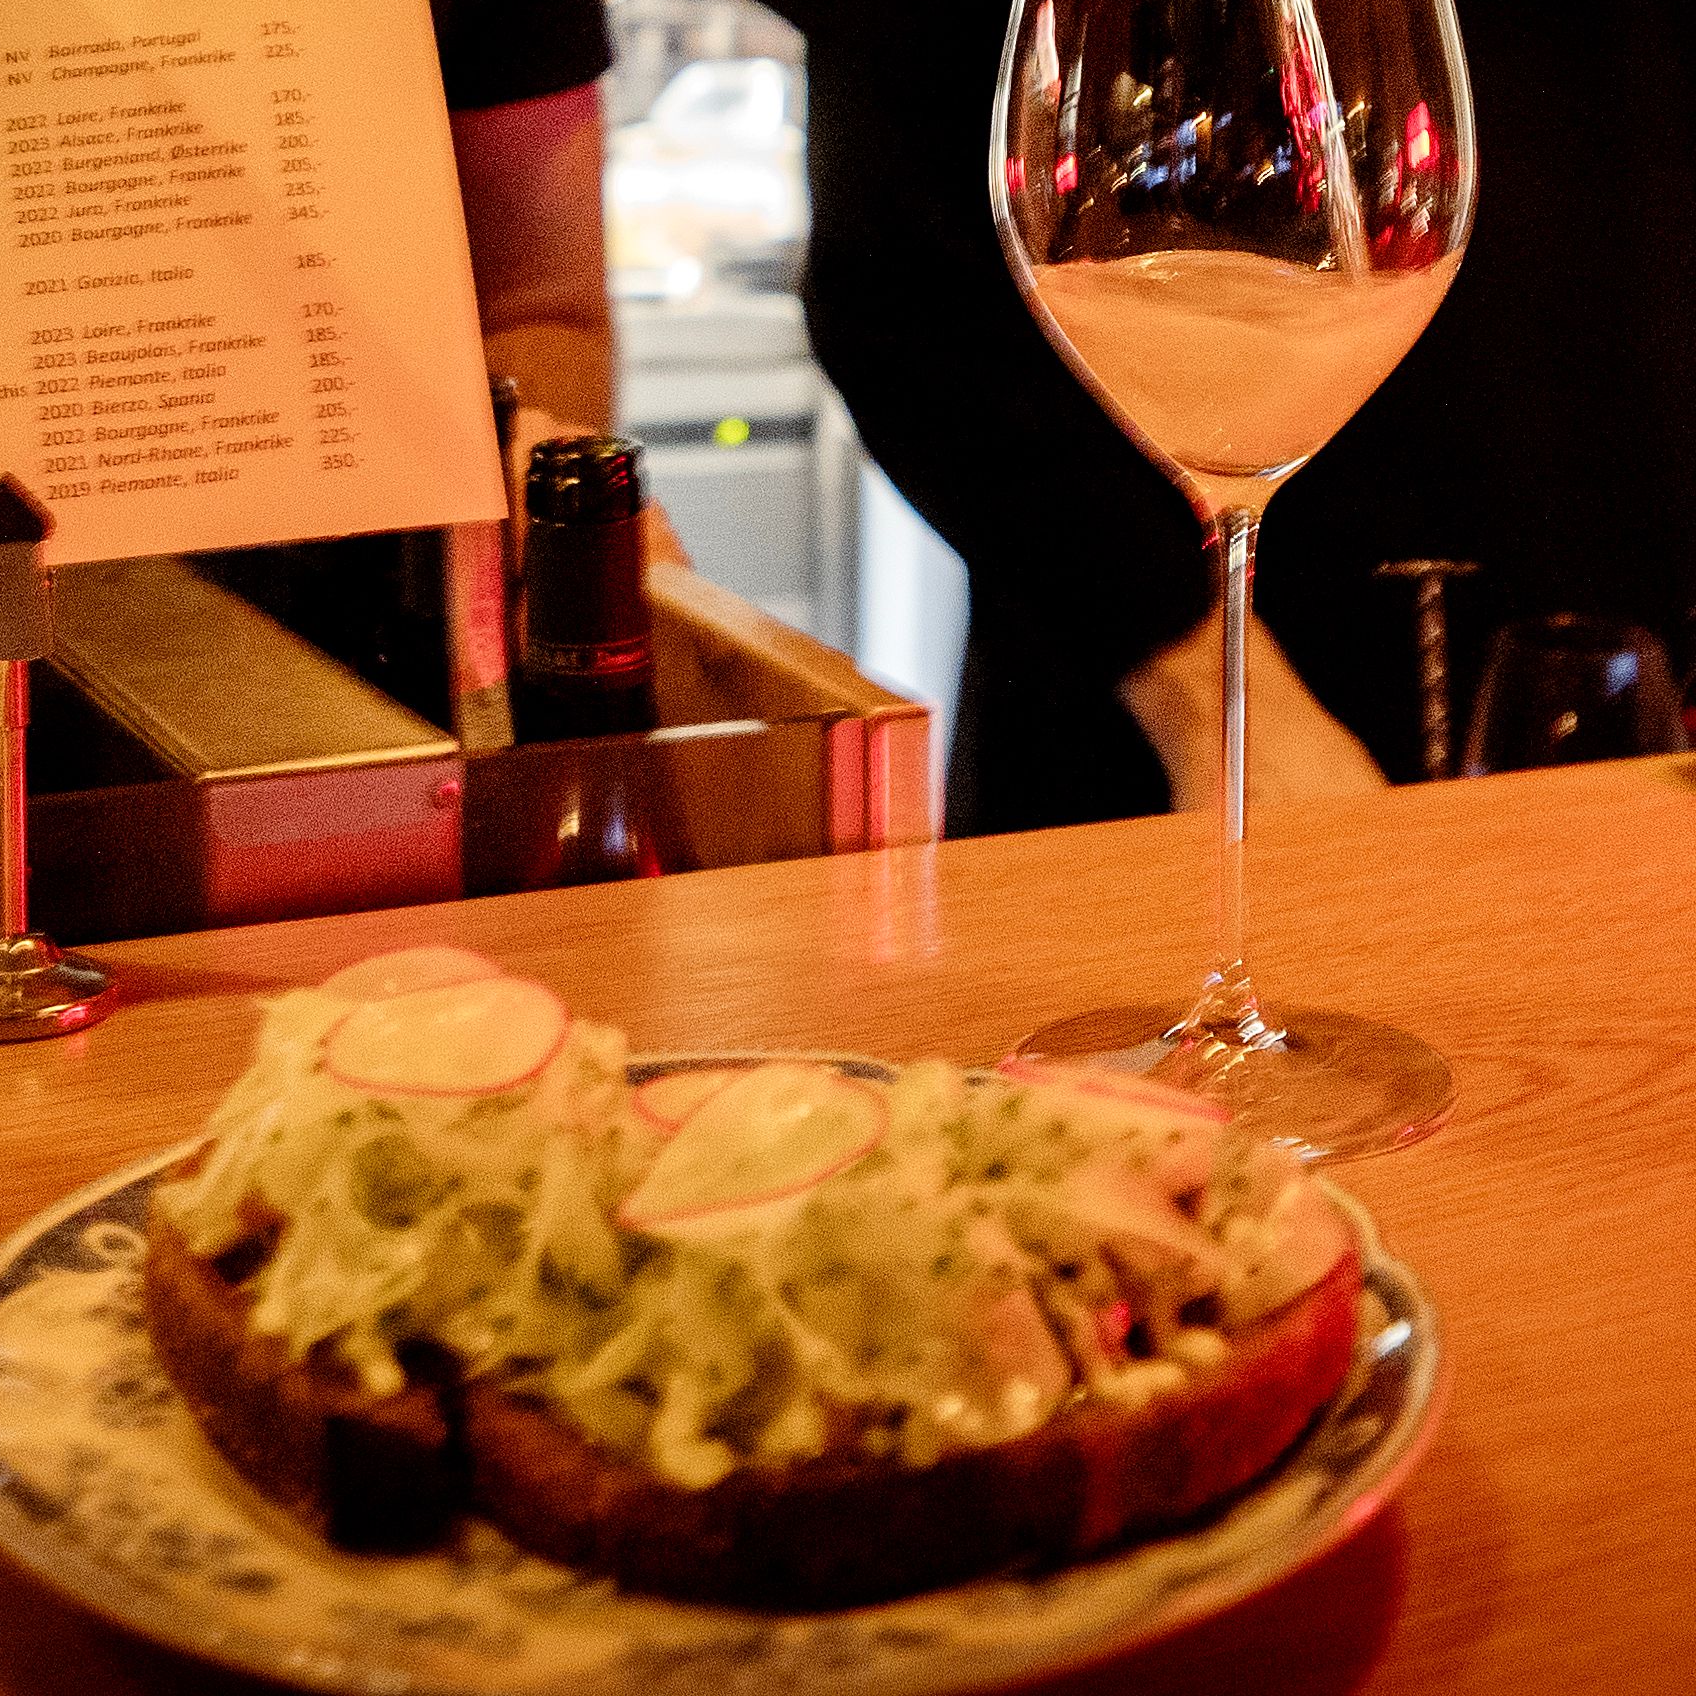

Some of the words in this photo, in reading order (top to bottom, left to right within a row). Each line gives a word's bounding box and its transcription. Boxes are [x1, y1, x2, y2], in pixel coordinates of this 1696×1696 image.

[1, 49, 30, 65] NV
[131, 30, 200, 49] Portugal
[260, 19, 302, 37] 175,-
[4, 70, 32, 87] NV
[50, 59, 154, 82] Champagne,
[160, 49, 235, 68] Frankrike
[264, 42, 306, 60] 225,-
[4, 113, 47, 134] 2022
[55, 110, 104, 127] Loire,
[108, 99, 185, 119] Frankrike
[271, 87, 312, 105] 170,-
[7, 136, 49, 156] 2023
[57, 131, 119, 148] Alsace,
[126, 120, 203, 140] Frankrike
[274, 109, 316, 128] 185,-
[9, 159, 51, 179] 2022
[169, 140, 247, 161] Østerrike
[277, 133, 319, 151] 200,-
[12, 182, 53, 202] 2022
[64, 175, 163, 195] Bourgogne,
[169, 163, 244, 183] Frankrike
[281, 156, 322, 174] 205,-
[15, 206, 57, 226] 2022
[114, 194, 190, 213] Frankrike
[285, 179, 326, 198] 235,-
[16, 229, 63, 250] 2020
[69, 221, 169, 243] Bourgogne,
[174, 210, 252, 231] Frankrike
[288, 203, 329, 221] 345,-
[23, 277, 68, 297] 2021
[147, 265, 194, 284] Italia
[295, 251, 336, 271] 185,-
[29, 325, 74, 347] 2023
[81, 323, 131, 341] Loire,
[135, 313, 215, 334] Frankrike
[301, 299, 343, 320] 170,-
[31, 350, 76, 372] 2023
[85, 344, 181, 365] Beaujolais,
[187, 333, 265, 354] Frankrike
[304, 324, 347, 345] 185,-
[33, 376, 78, 397] 2022
[88, 369, 175, 389] Piemonte,
[181, 362, 226, 381] Italia
[308, 349, 351, 370] 185,-
[36, 401, 83, 423] 2020
[157, 390, 215, 411] Spania
[310, 374, 354, 395] 200,-
[41, 427, 84, 448] 2022
[93, 420, 194, 442] Bourgogne,
[200, 408, 279, 430] Frankrike
[313, 400, 358, 420] 205,-
[44, 454, 87, 475] 2021
[214, 433, 293, 455] Frankrike
[318, 425, 362, 446] 225,-
[44, 478, 92, 502] 2019
[97, 473, 187, 495] Piemonte,
[192, 465, 239, 486] Italia
[321, 451, 365, 472] 350,-
